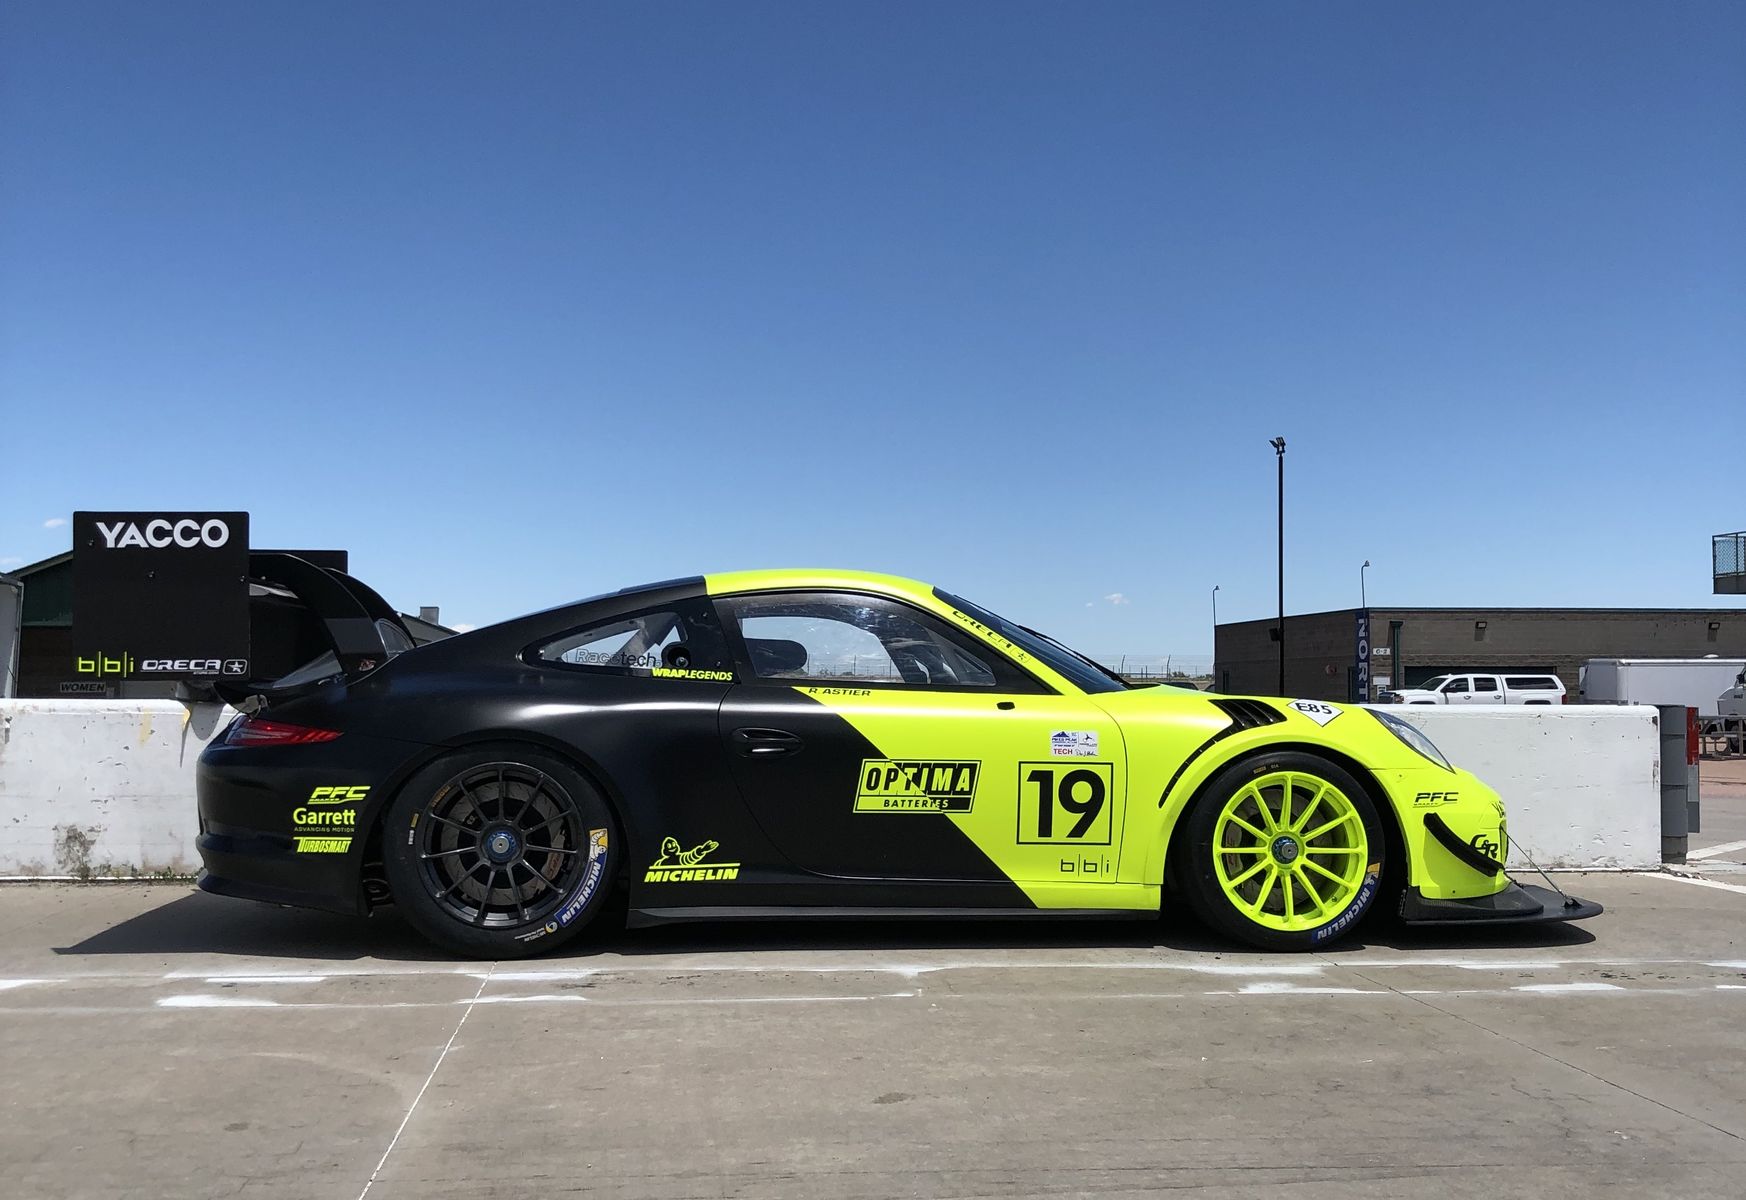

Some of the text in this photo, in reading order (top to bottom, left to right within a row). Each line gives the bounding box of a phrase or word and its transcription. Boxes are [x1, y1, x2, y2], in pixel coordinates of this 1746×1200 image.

[96, 519, 229, 548] YACCO
[142, 659, 221, 670] ORECA
[1358, 618, 1368, 704] NORT
[652, 667, 733, 681] WRAPLEGENDS
[61, 683, 105, 692] WOMEN
[823, 688, 871, 697] ASTIER
[1295, 703, 1332, 715] E85
[865, 767, 971, 792] OPTIMA
[310, 786, 371, 799] PFC
[1414, 792, 1459, 803] PFC
[883, 799, 949, 808] BATTERIES
[1027, 769, 1106, 838] 19
[293, 807, 356, 825] Garrett
[644, 868, 739, 882] MICHELIN
[561, 861, 602, 923] MICHELIN
[1317, 887, 1371, 940] MICHELIN
